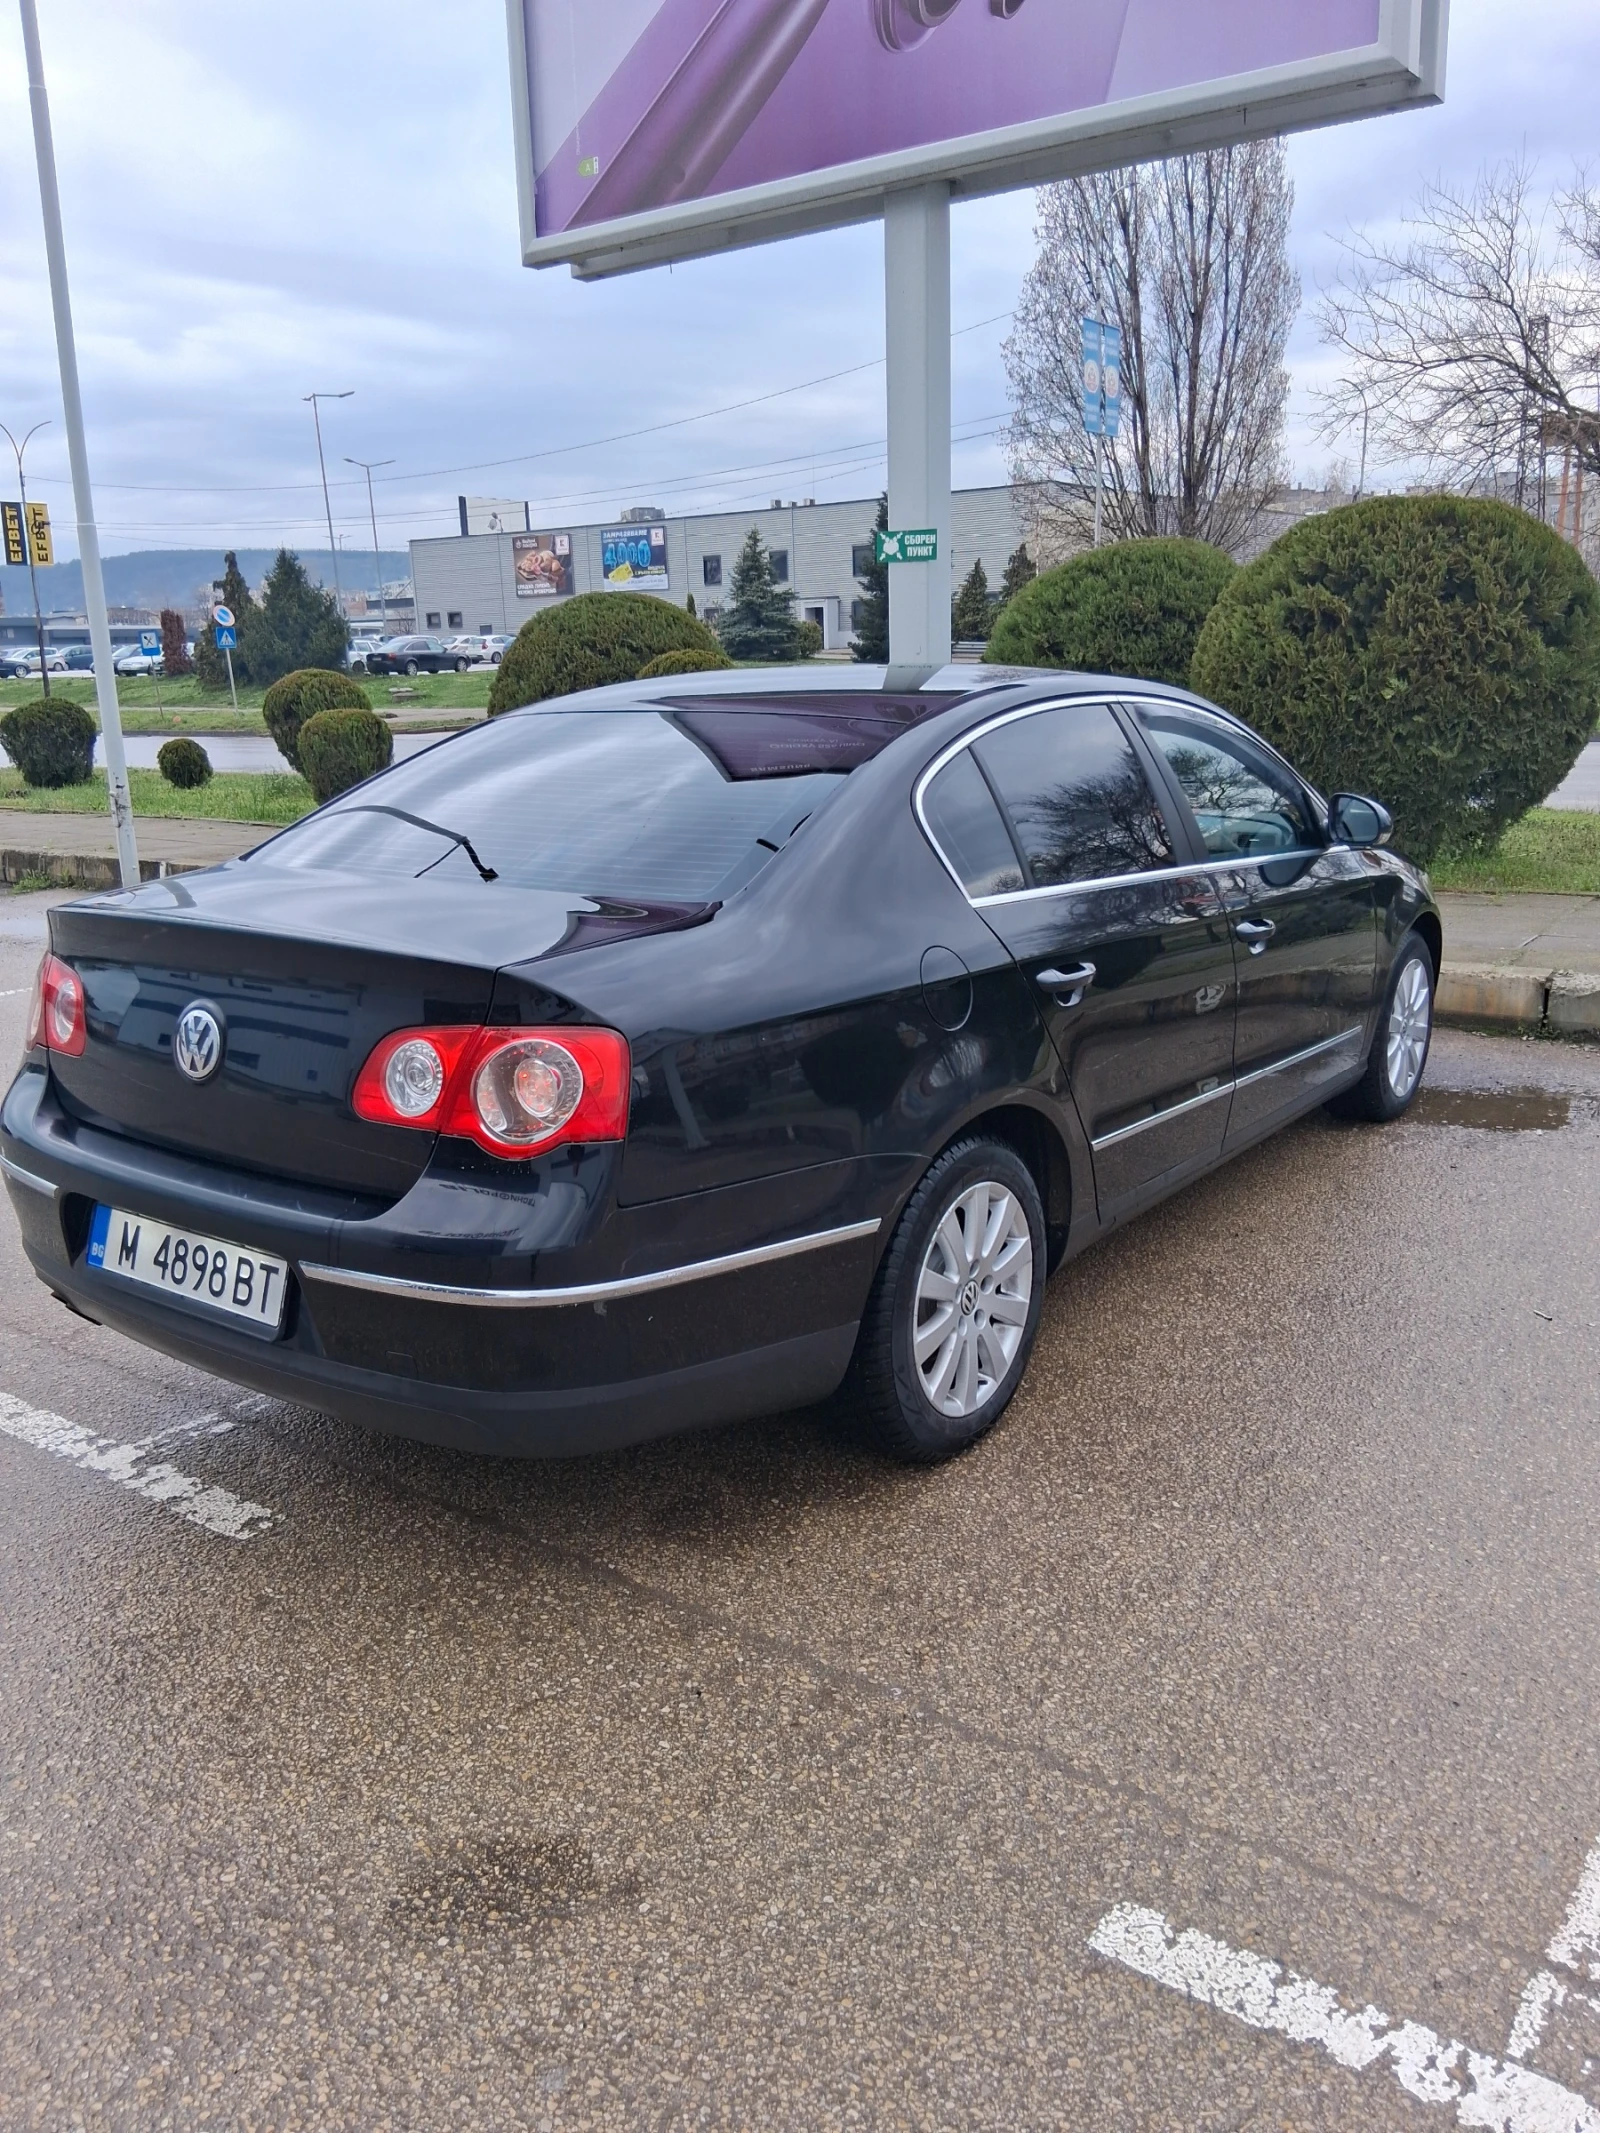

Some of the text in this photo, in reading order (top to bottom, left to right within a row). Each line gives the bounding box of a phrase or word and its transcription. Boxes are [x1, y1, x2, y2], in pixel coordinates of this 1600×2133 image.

[5, 505, 23, 562] EFBET
[32, 507, 49, 562] EFBET
[904, 534, 936, 545] СБОРЕН
[604, 540, 651, 569] 4000
[907, 546, 933, 557] ПУНКТ
[91, 1242, 105, 1258] BG
[118, 1221, 141, 1270] M
